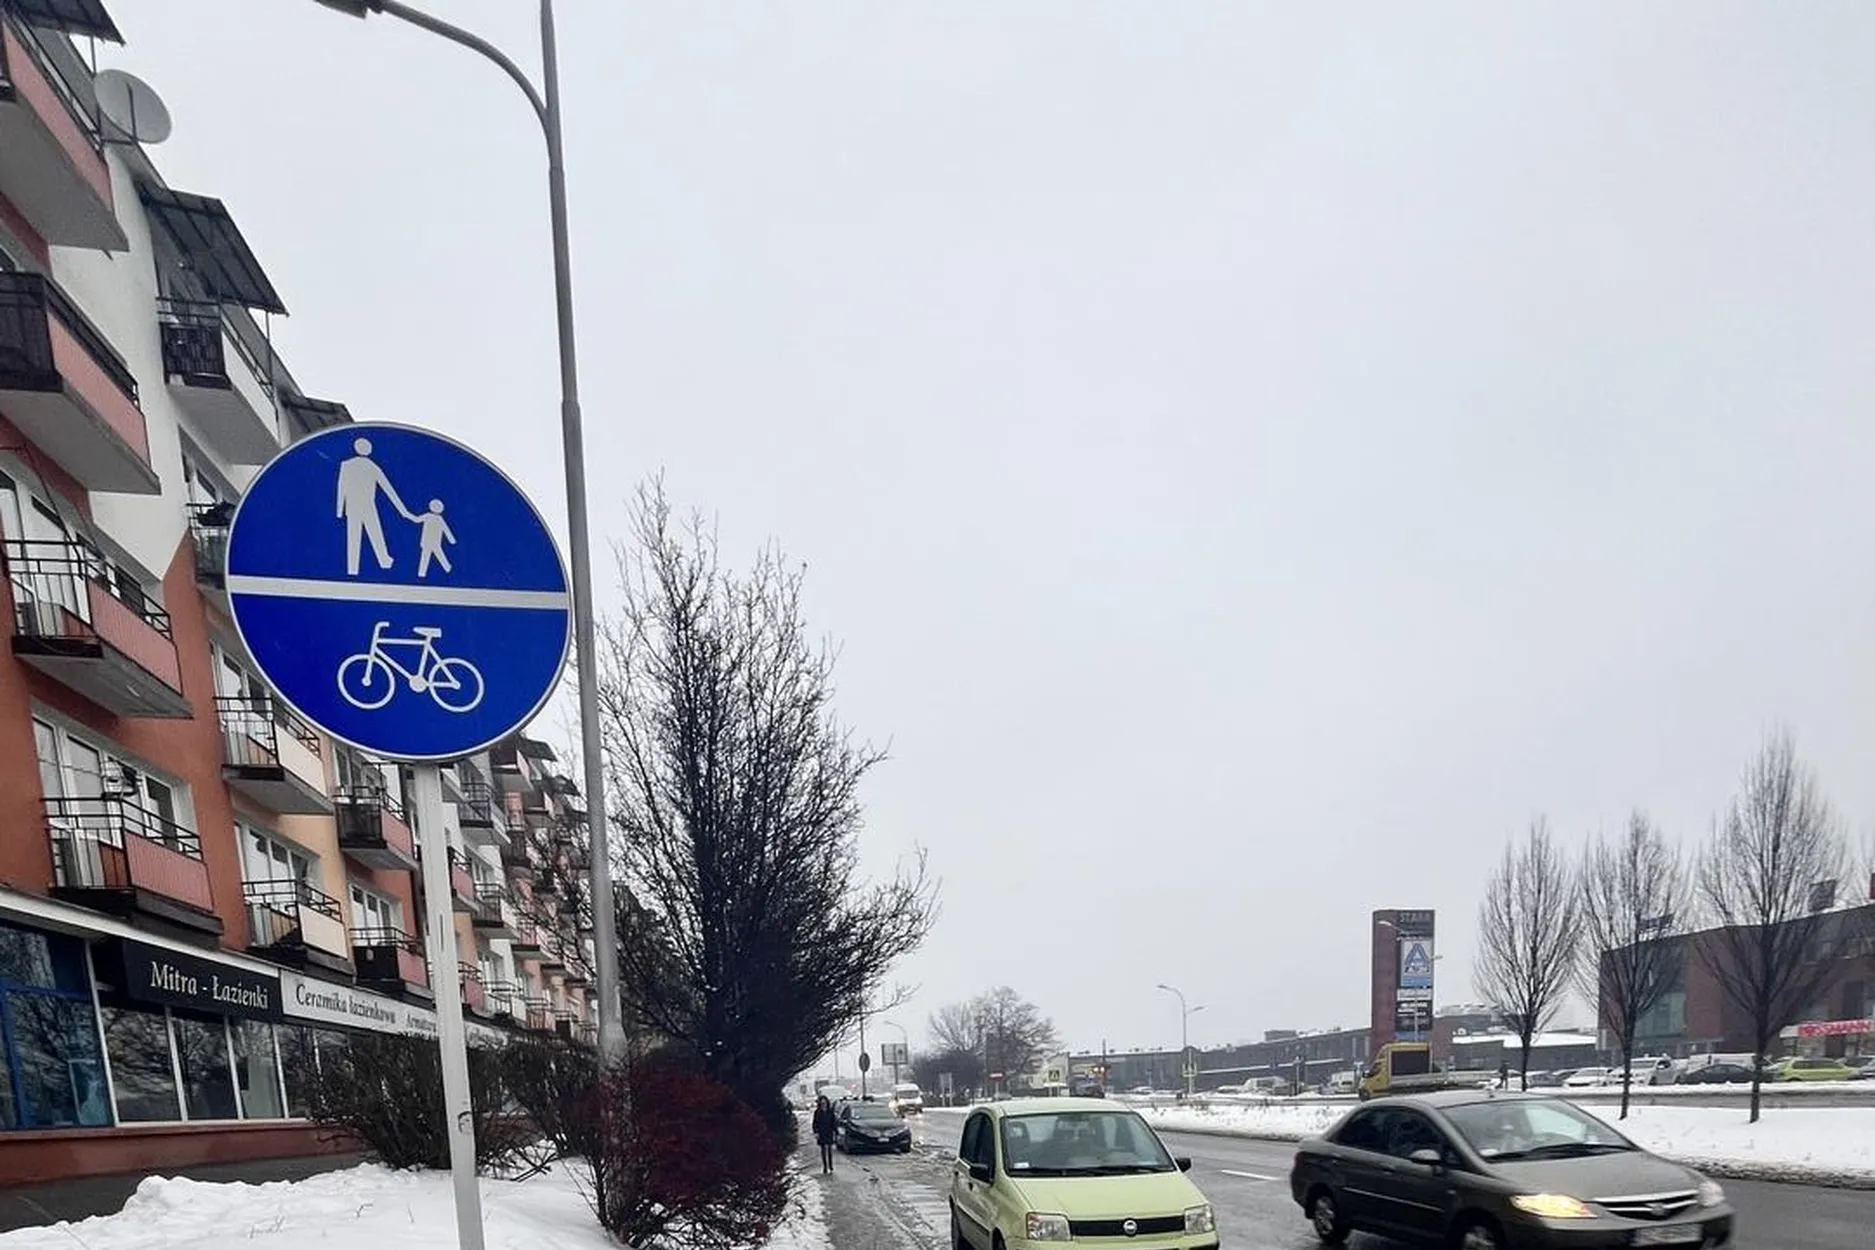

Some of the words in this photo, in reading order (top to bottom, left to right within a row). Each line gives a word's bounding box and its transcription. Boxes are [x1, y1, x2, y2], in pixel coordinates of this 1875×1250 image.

[150, 961, 198, 995] Mitra
[211, 975, 269, 1009] Łazienki
[296, 983, 347, 1013] Ceramika
